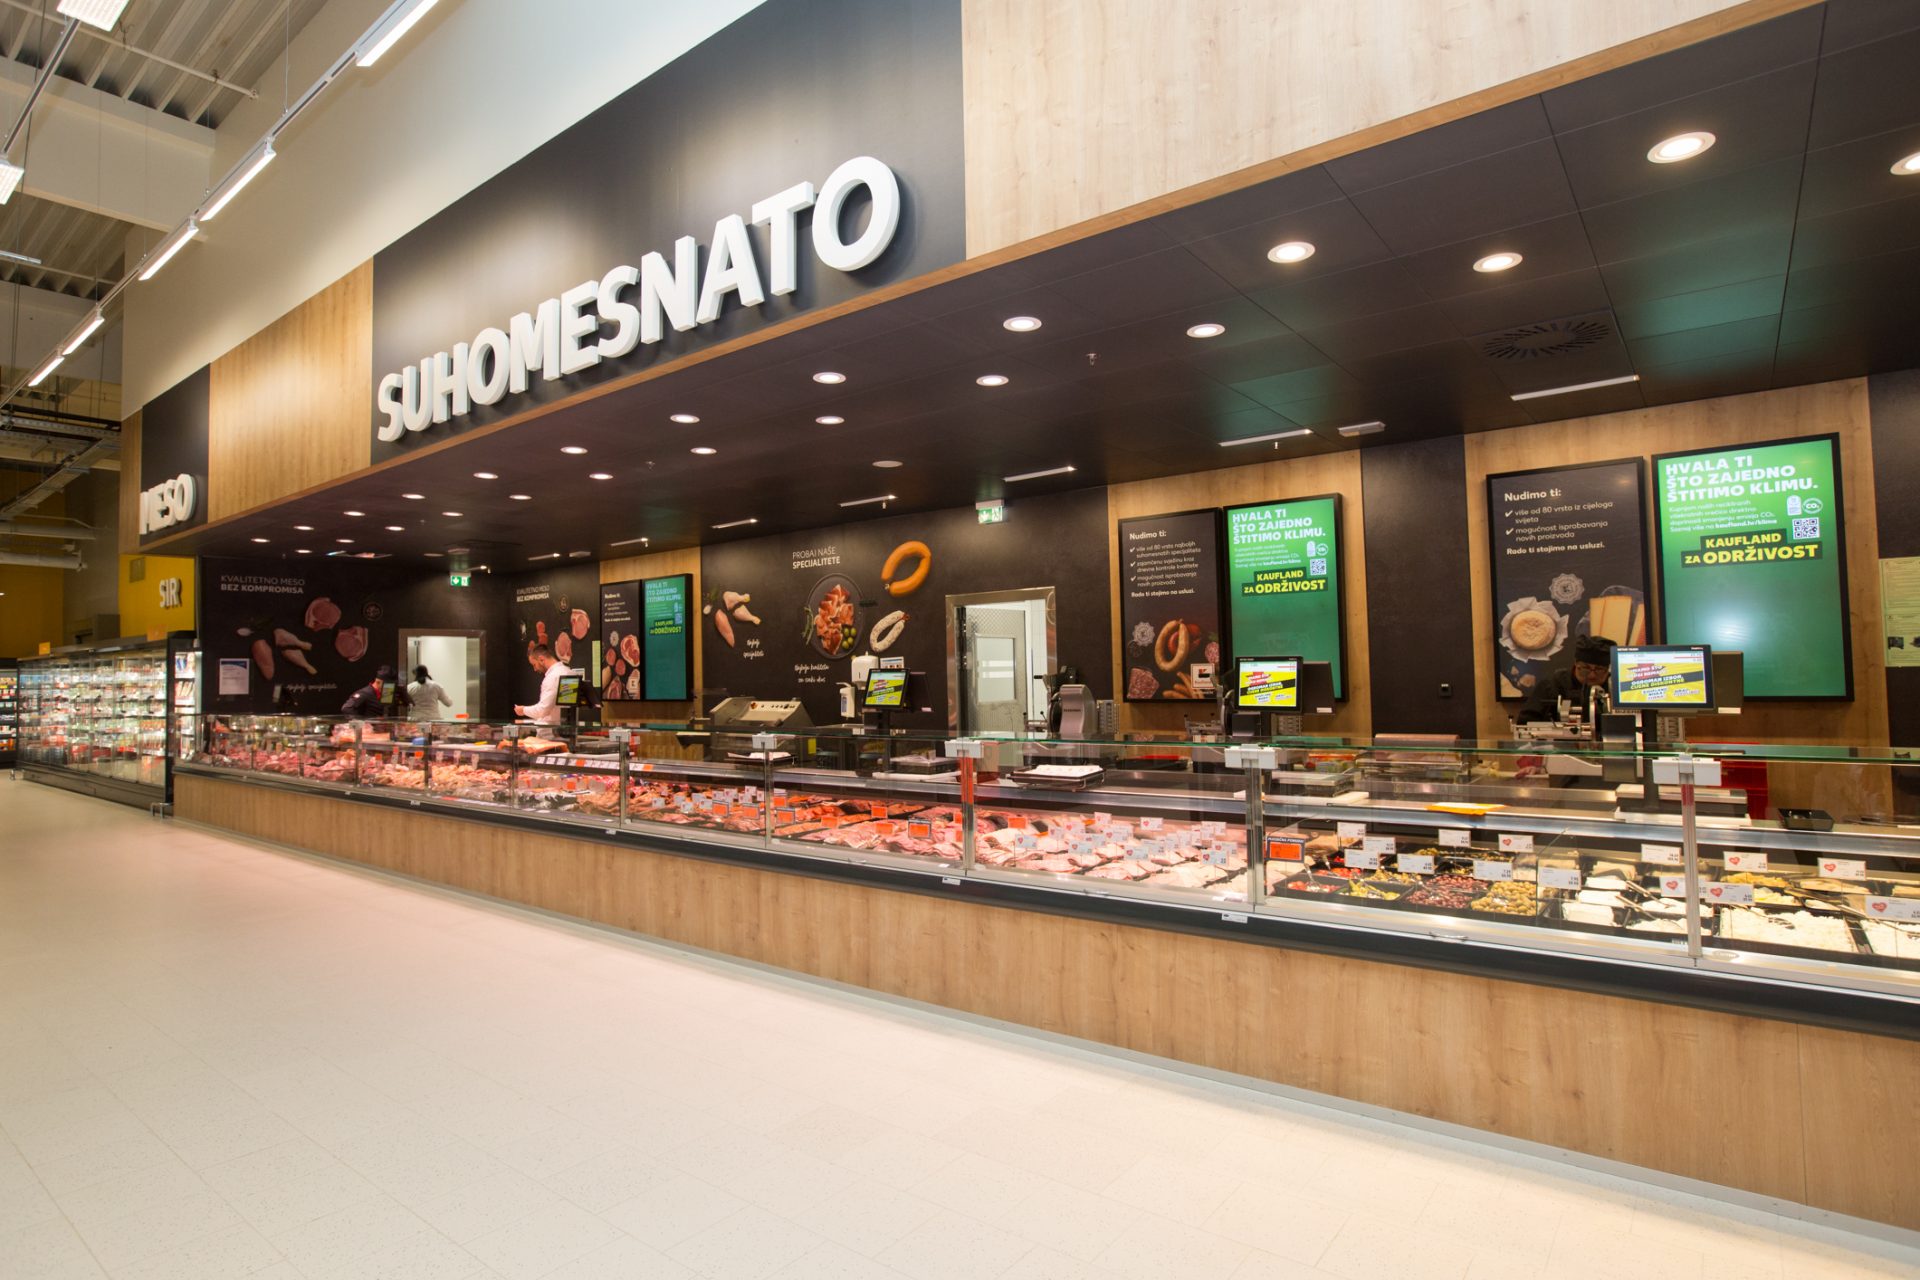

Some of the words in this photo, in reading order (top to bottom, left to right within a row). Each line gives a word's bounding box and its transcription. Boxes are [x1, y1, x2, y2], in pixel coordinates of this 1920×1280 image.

[377, 156, 900, 442] SUHOMESNATO
[1666, 458, 1728, 475] HVALA
[1734, 456, 1752, 468] TI
[1666, 474, 1702, 489] ŠTO
[1708, 465, 1796, 484] ZAJEDNO
[1504, 490, 1546, 502] Nudimo
[1550, 488, 1562, 496] ti:
[1668, 486, 1744, 502] ŠTITIMO
[1750, 478, 1818, 495] KLIMU.
[1554, 504, 1572, 512] vrsta
[1582, 501, 1614, 510] cijeloga
[1232, 511, 1272, 522] HVALA
[1275, 508, 1286, 518] TI
[1233, 522, 1256, 533] ŠTO
[1258, 518, 1312, 531] ZAJEDNO
[1130, 532, 1157, 540] Nudimo
[1234, 532, 1282, 544] ŠTITIMO
[1284, 528, 1326, 540] KLIMU.
[1538, 532, 1574, 541] proizvoda
[1706, 533, 1782, 548] KAUFLAND
[1506, 547, 1526, 555] Rado
[1536, 544, 1565, 554] stojimo
[1685, 555, 1701, 564] ZA
[1703, 545, 1818, 564] ODRŽIVOST
[792, 556, 840, 570] SPECIJALITETE
[220, 575, 278, 584] KVALITETNO
[280, 578, 305, 586] MESO
[1256, 570, 1304, 581] KAUFLAND
[160, 577, 181, 608] SIR
[240, 584, 304, 594] KOMPROMISA
[1256, 580, 1326, 594] ODRŽIVOST
